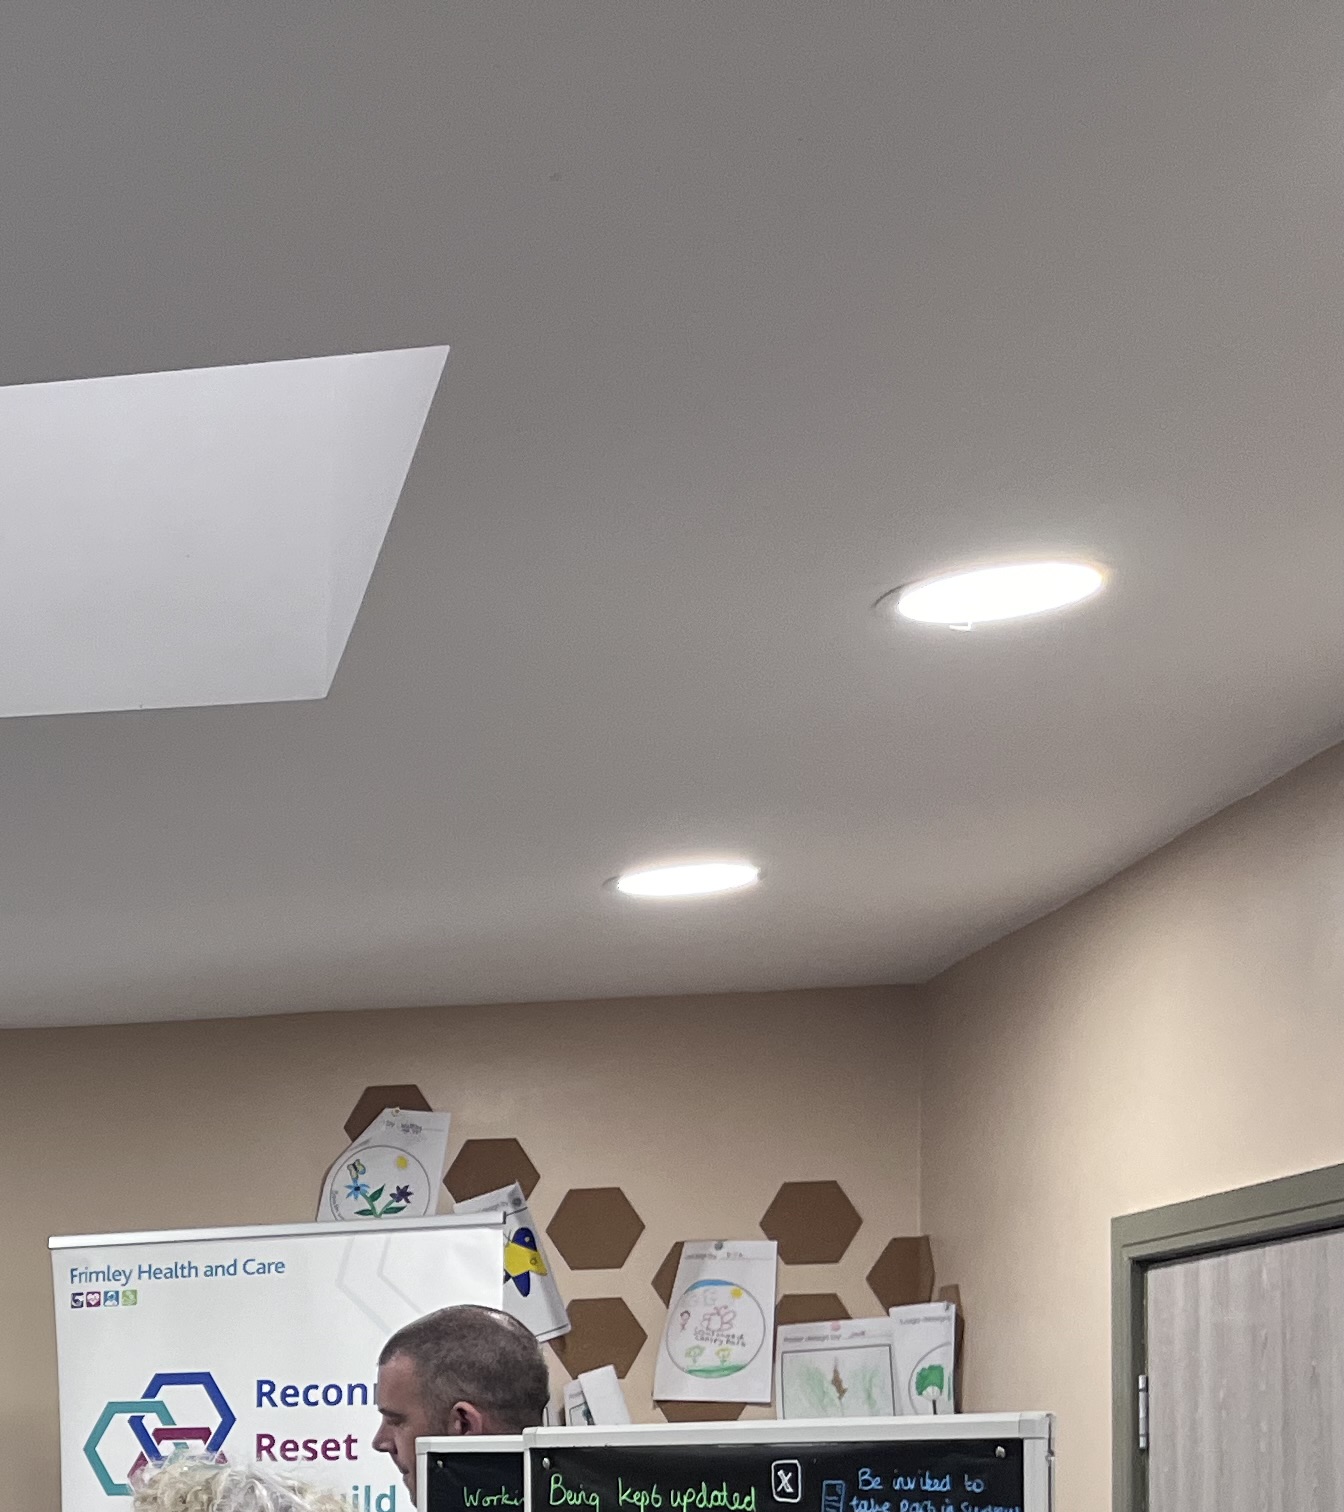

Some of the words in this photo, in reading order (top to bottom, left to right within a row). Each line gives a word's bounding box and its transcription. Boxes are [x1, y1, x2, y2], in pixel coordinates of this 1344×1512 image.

[70, 1267, 132, 1286] Frimley
[137, 1261, 198, 1281] Health
[204, 1259, 237, 1277] and
[242, 1258, 285, 1274] Care
[256, 1433, 358, 1461] Reset
[858, 1468, 883, 1491] Be
[893, 1469, 952, 1492] invited
[964, 1475, 985, 1493] to
